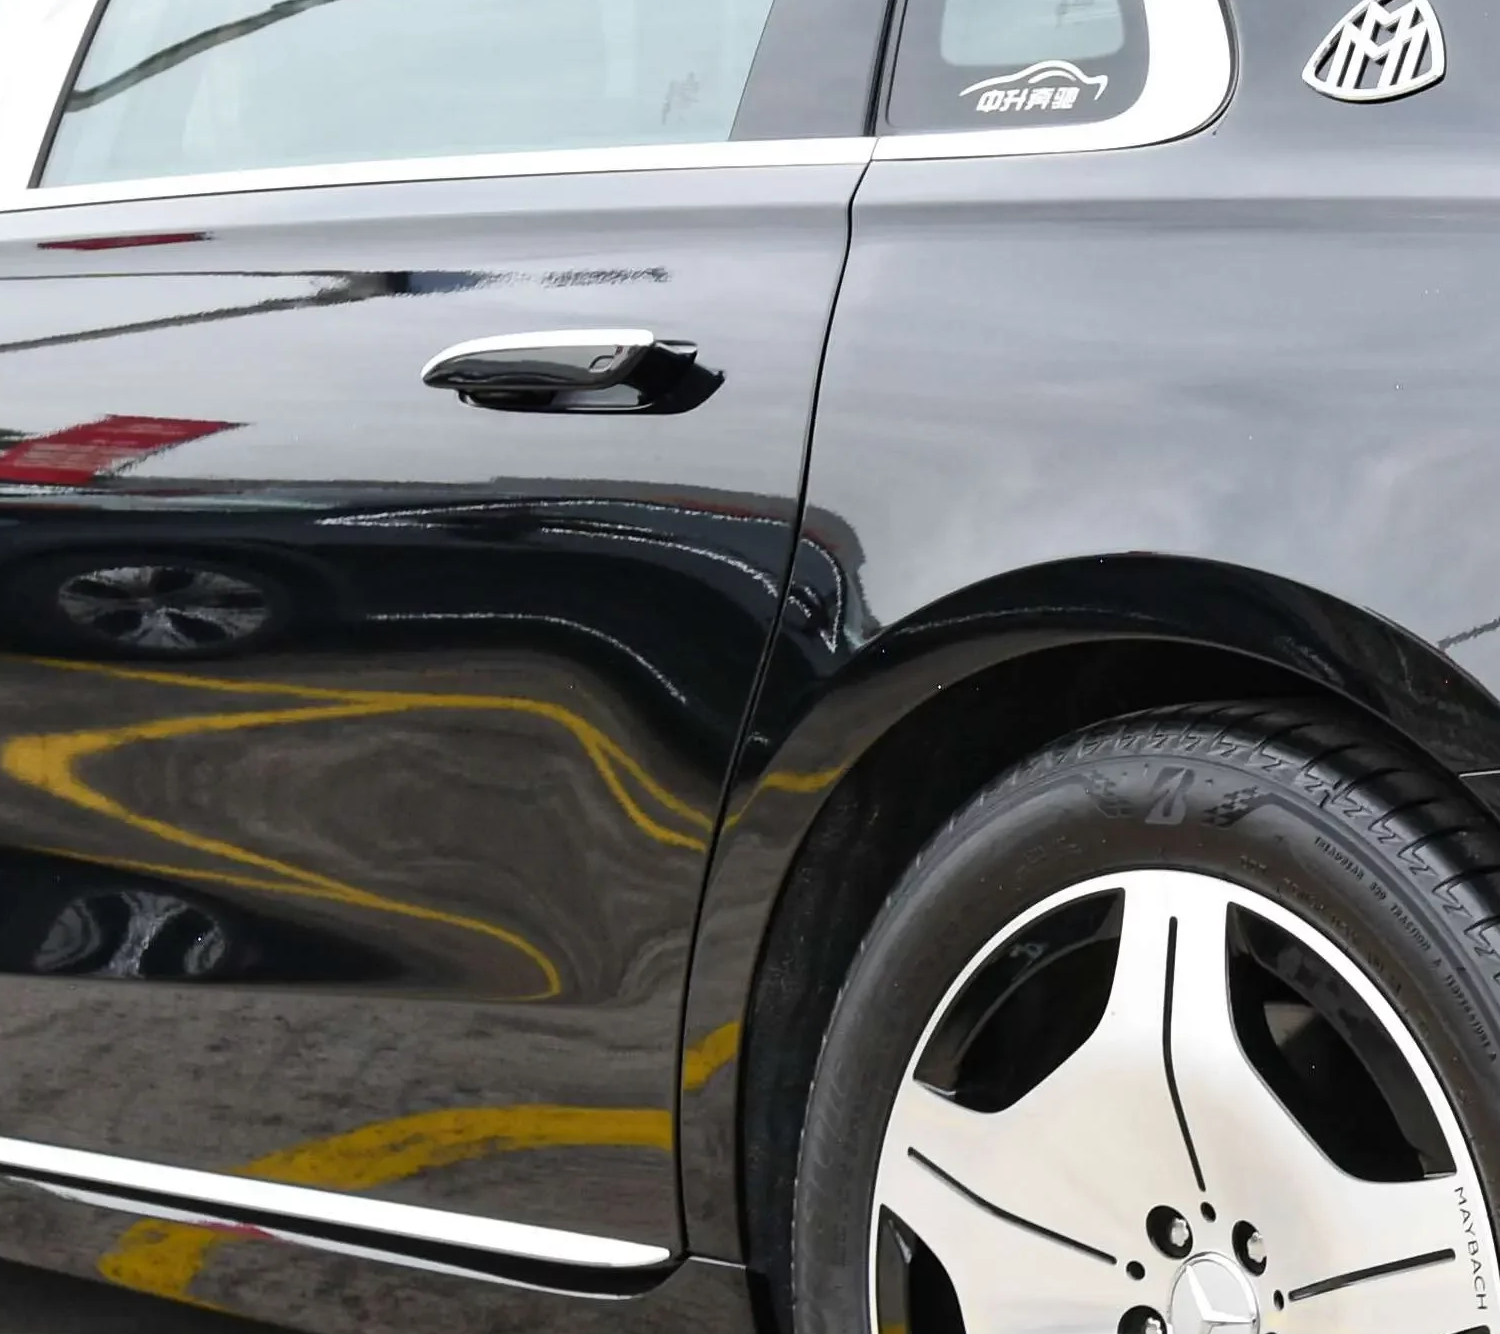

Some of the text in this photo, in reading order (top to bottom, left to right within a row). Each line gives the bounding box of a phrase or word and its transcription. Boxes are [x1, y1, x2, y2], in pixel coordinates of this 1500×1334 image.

[975, 85, 1081, 112] 中升奔驰
[1453, 1185, 1489, 1311] MAYBACH
